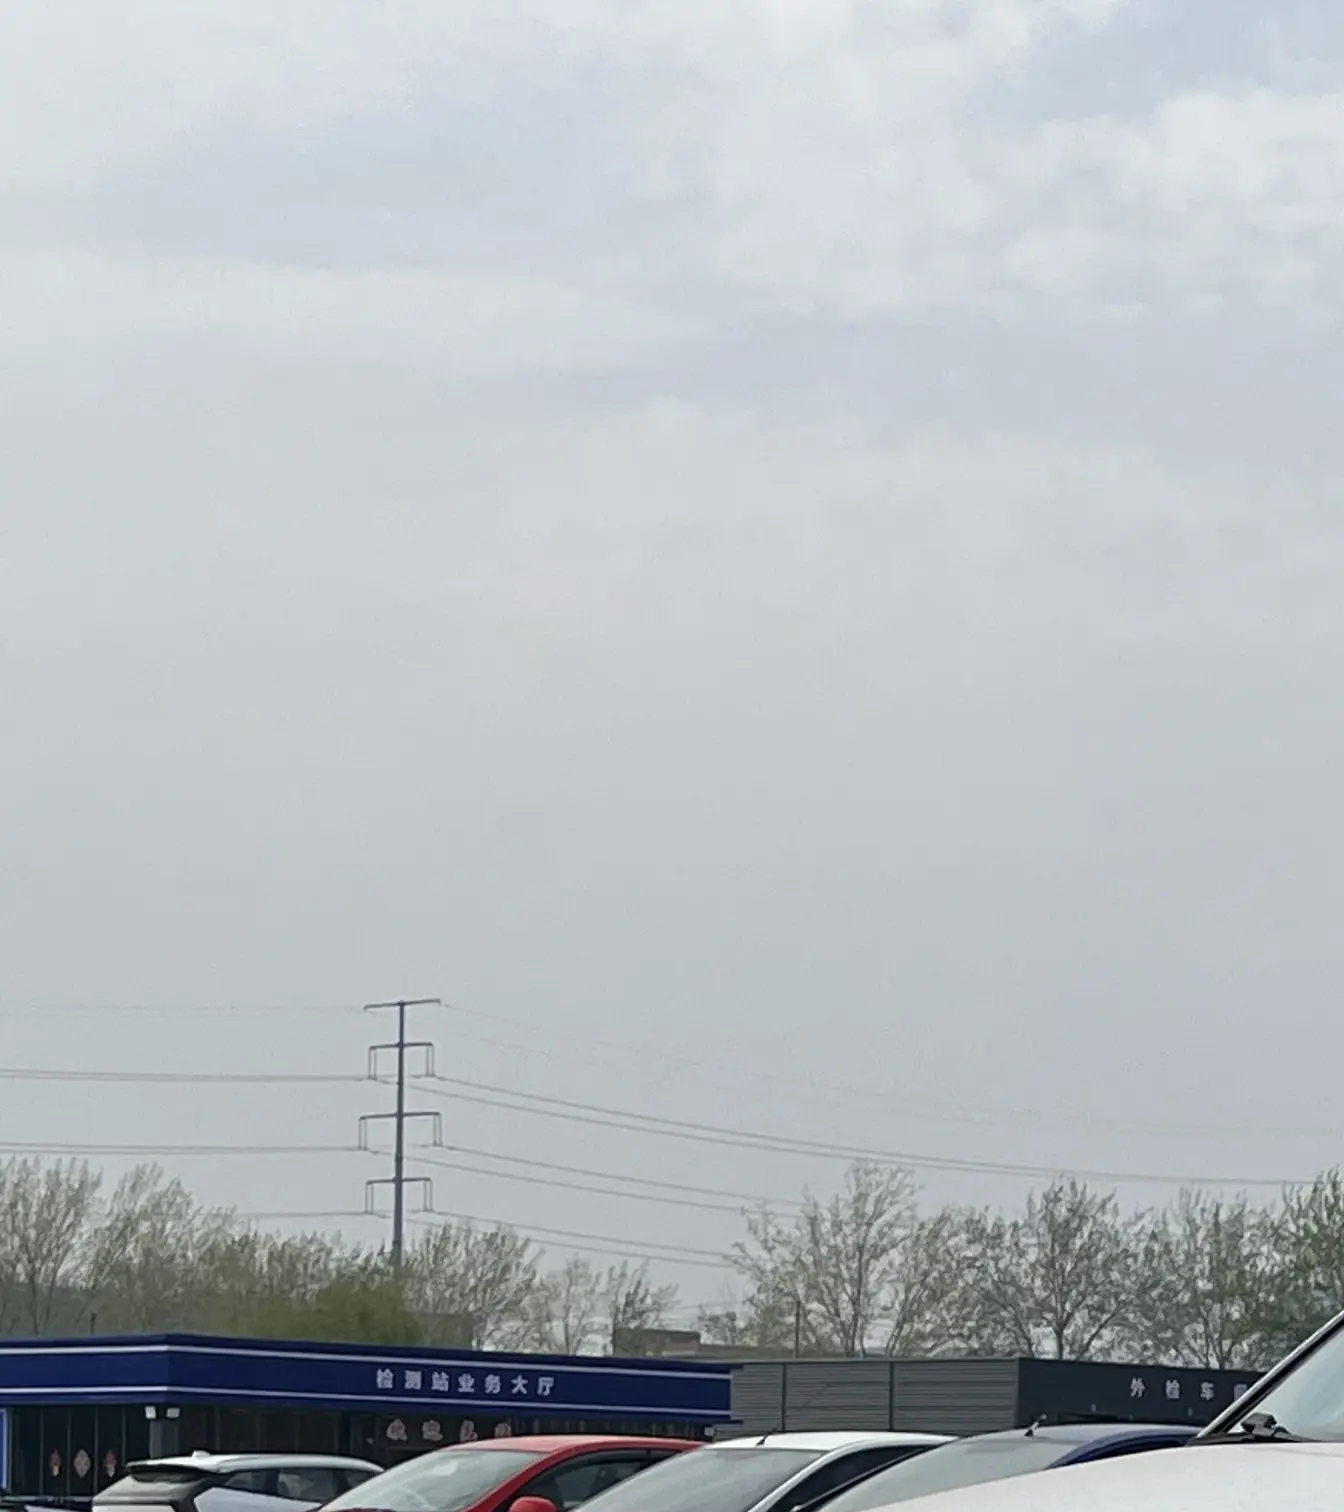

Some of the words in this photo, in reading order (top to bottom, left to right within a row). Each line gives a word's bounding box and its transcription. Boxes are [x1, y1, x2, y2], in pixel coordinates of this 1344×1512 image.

[376, 1368, 555, 1396] 检测站业务大厅
